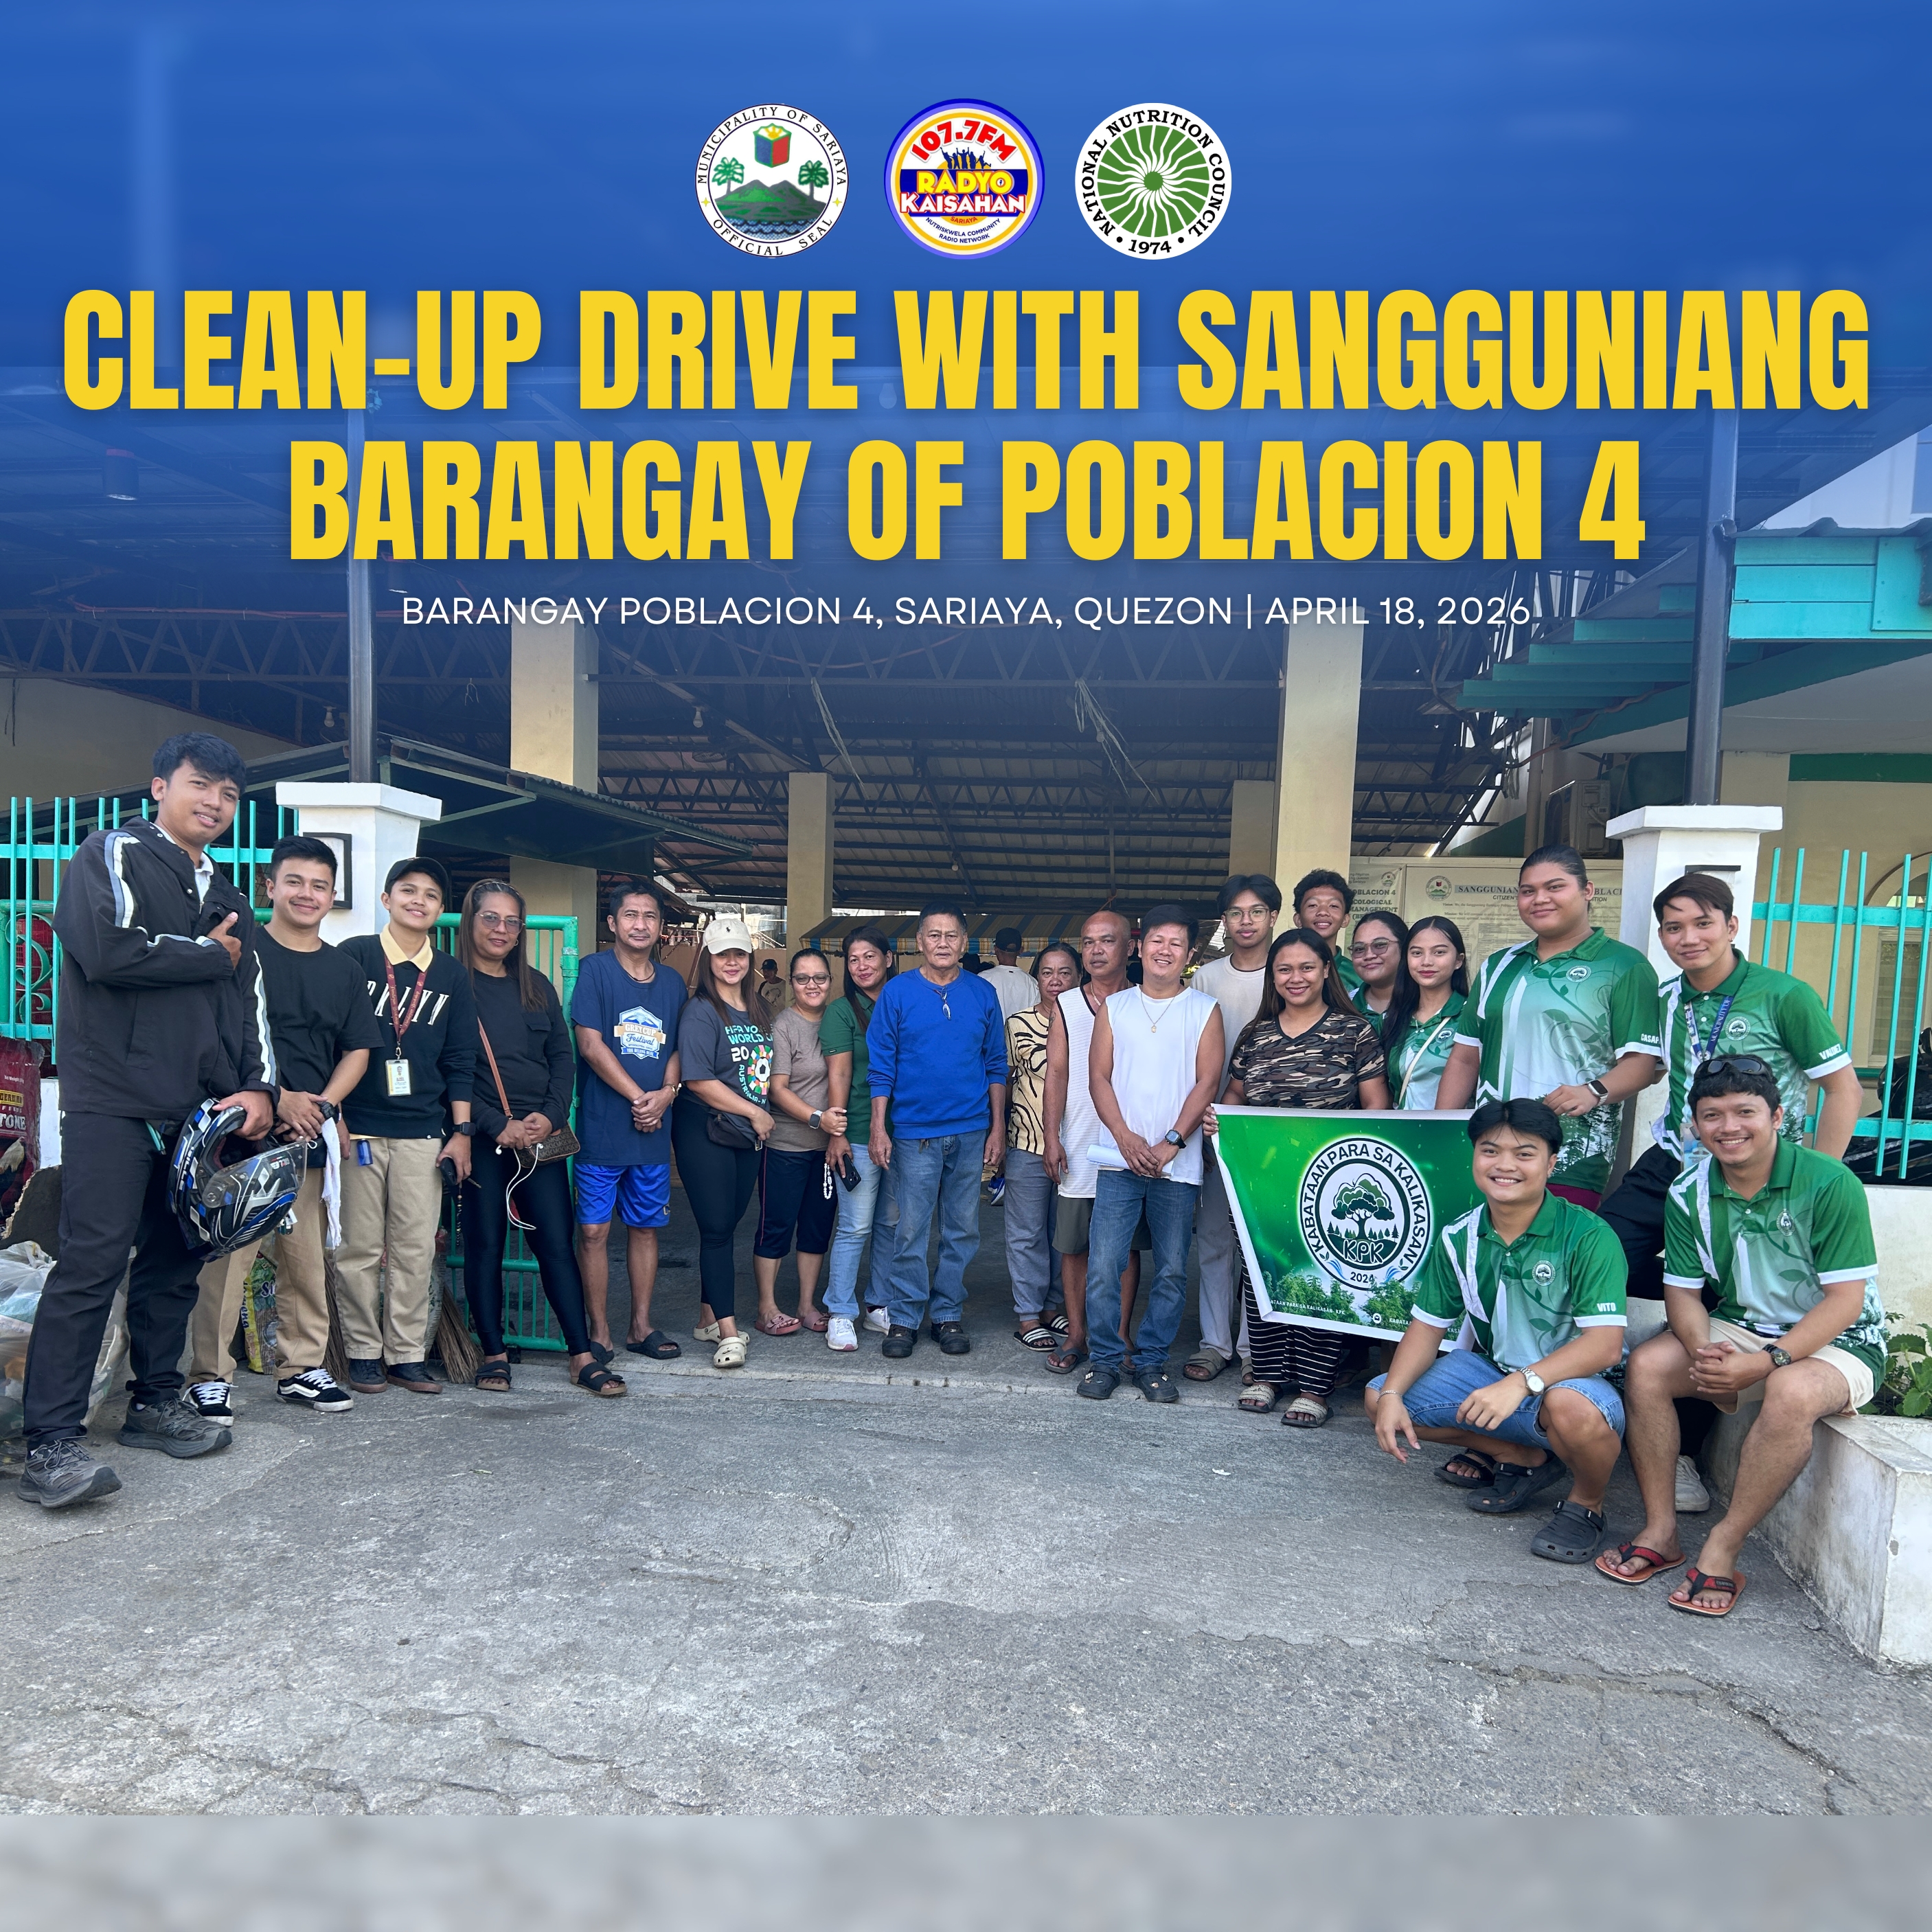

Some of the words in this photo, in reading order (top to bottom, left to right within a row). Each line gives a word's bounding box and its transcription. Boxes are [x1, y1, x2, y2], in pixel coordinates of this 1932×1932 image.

[625, 1023, 643, 1034] GREY
[642, 1027, 657, 1036] CUP
[725, 1025, 744, 1035] FIFA
[626, 1034, 656, 1045] Festival
[728, 1033, 764, 1045] WORLD
[1641, 1033, 1661, 1045] CASAP
[731, 1045, 749, 1062] 20
[738, 1064, 766, 1105] AUSTRALIA-N
[0, 1113, 27, 1130] TONE
[1304, 1159, 1329, 1253] KABATAAN
[1326, 1144, 1370, 1166] PARA
[1373, 1146, 1395, 1168] SA
[1394, 1162, 1426, 1264] KALIKASAN
[1343, 1239, 1384, 1264] KPK
[1350, 1271, 1375, 1284] 2024
[261, 1280, 276, 1298] Si
[1597, 1302, 1616, 1312] VITO
